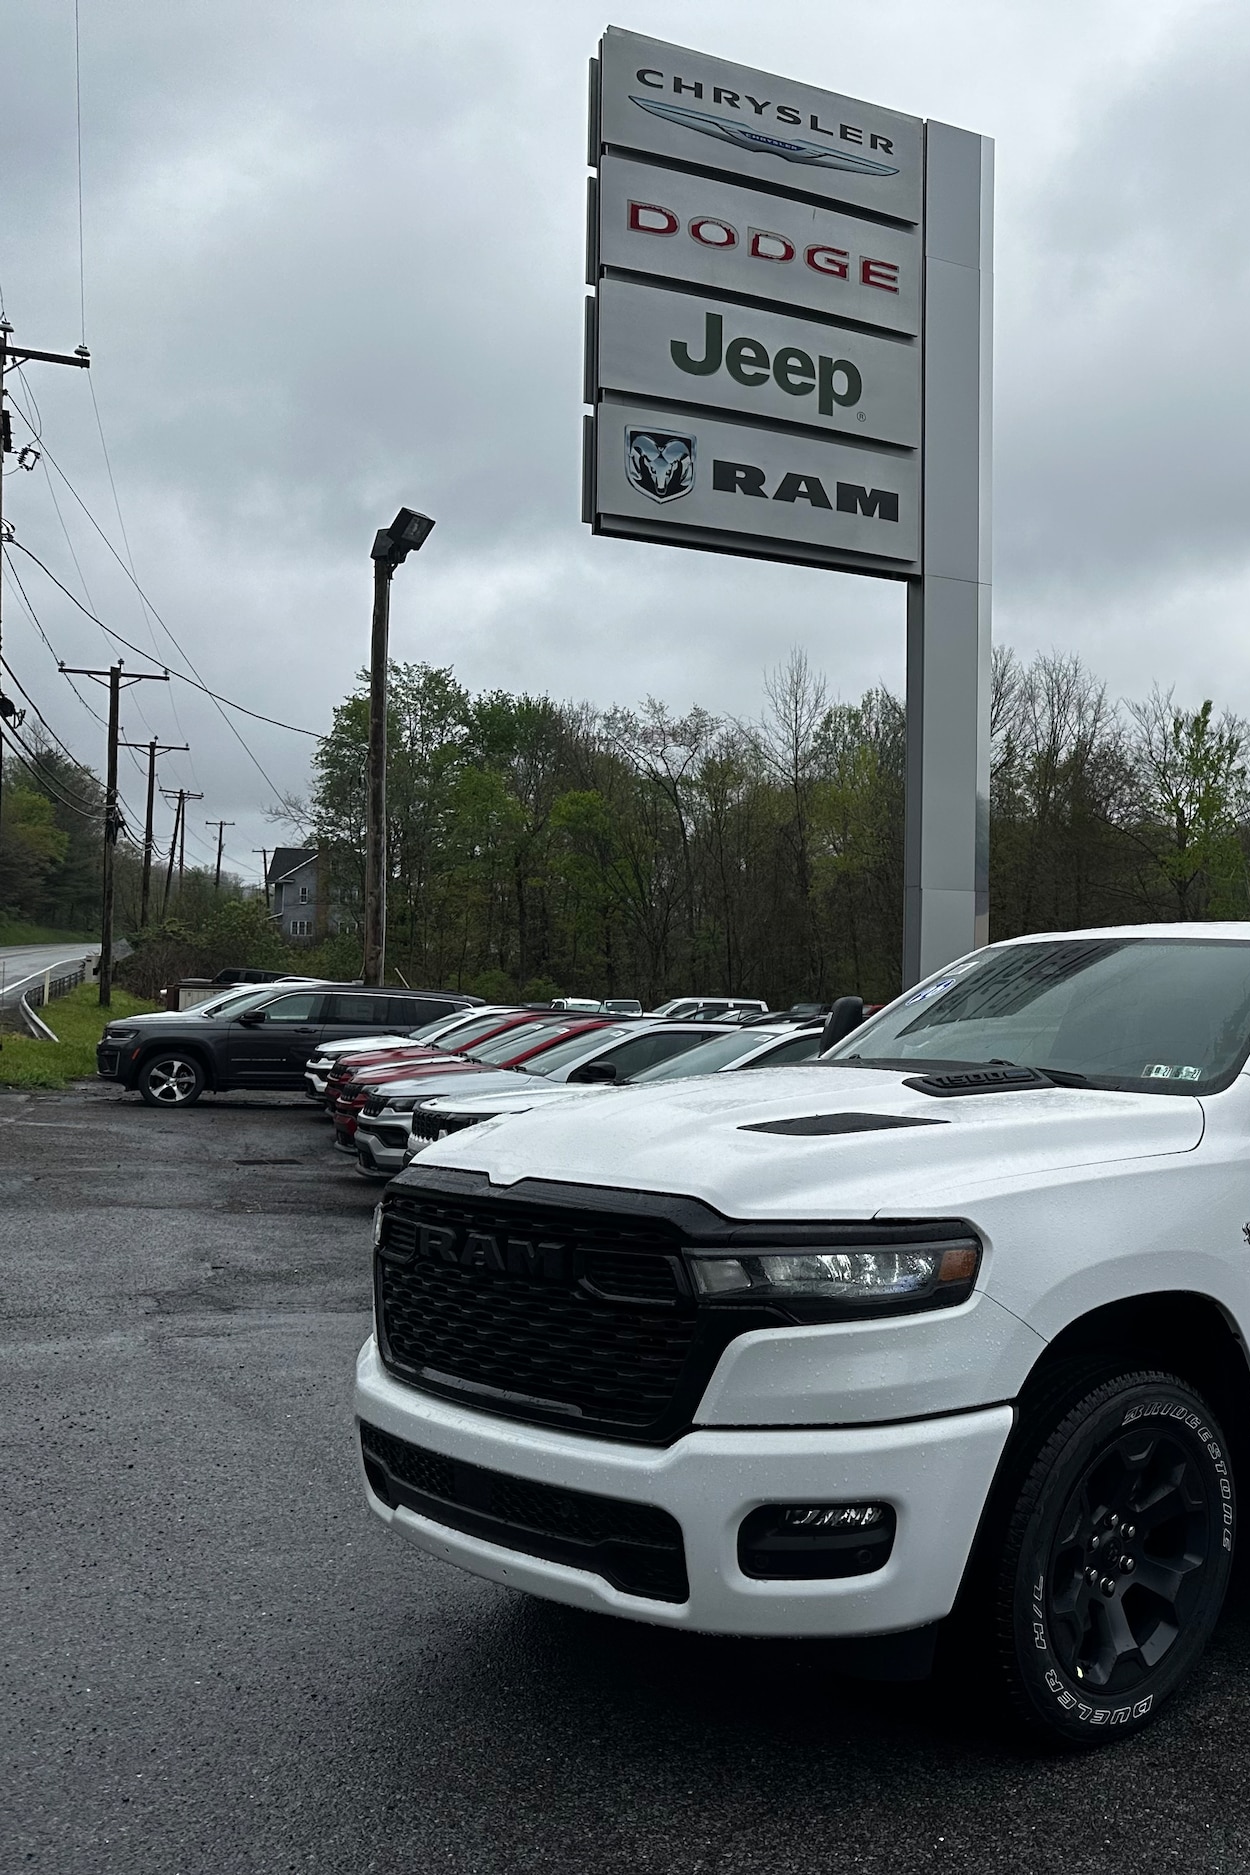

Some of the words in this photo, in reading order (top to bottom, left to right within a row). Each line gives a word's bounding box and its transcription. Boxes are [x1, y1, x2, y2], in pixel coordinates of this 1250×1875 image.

[636, 68, 895, 156] CHRYSLER
[745, 132, 798, 151] CHRYSLER
[627, 199, 900, 295] DODGE
[670, 311, 862, 416] Jeep
[713, 459, 899, 522] RAM
[418, 1225, 567, 1280] RAM
[1121, 1401, 1233, 1551] BRIDGESTONE
[1045, 1669, 1154, 1725] DUELER
